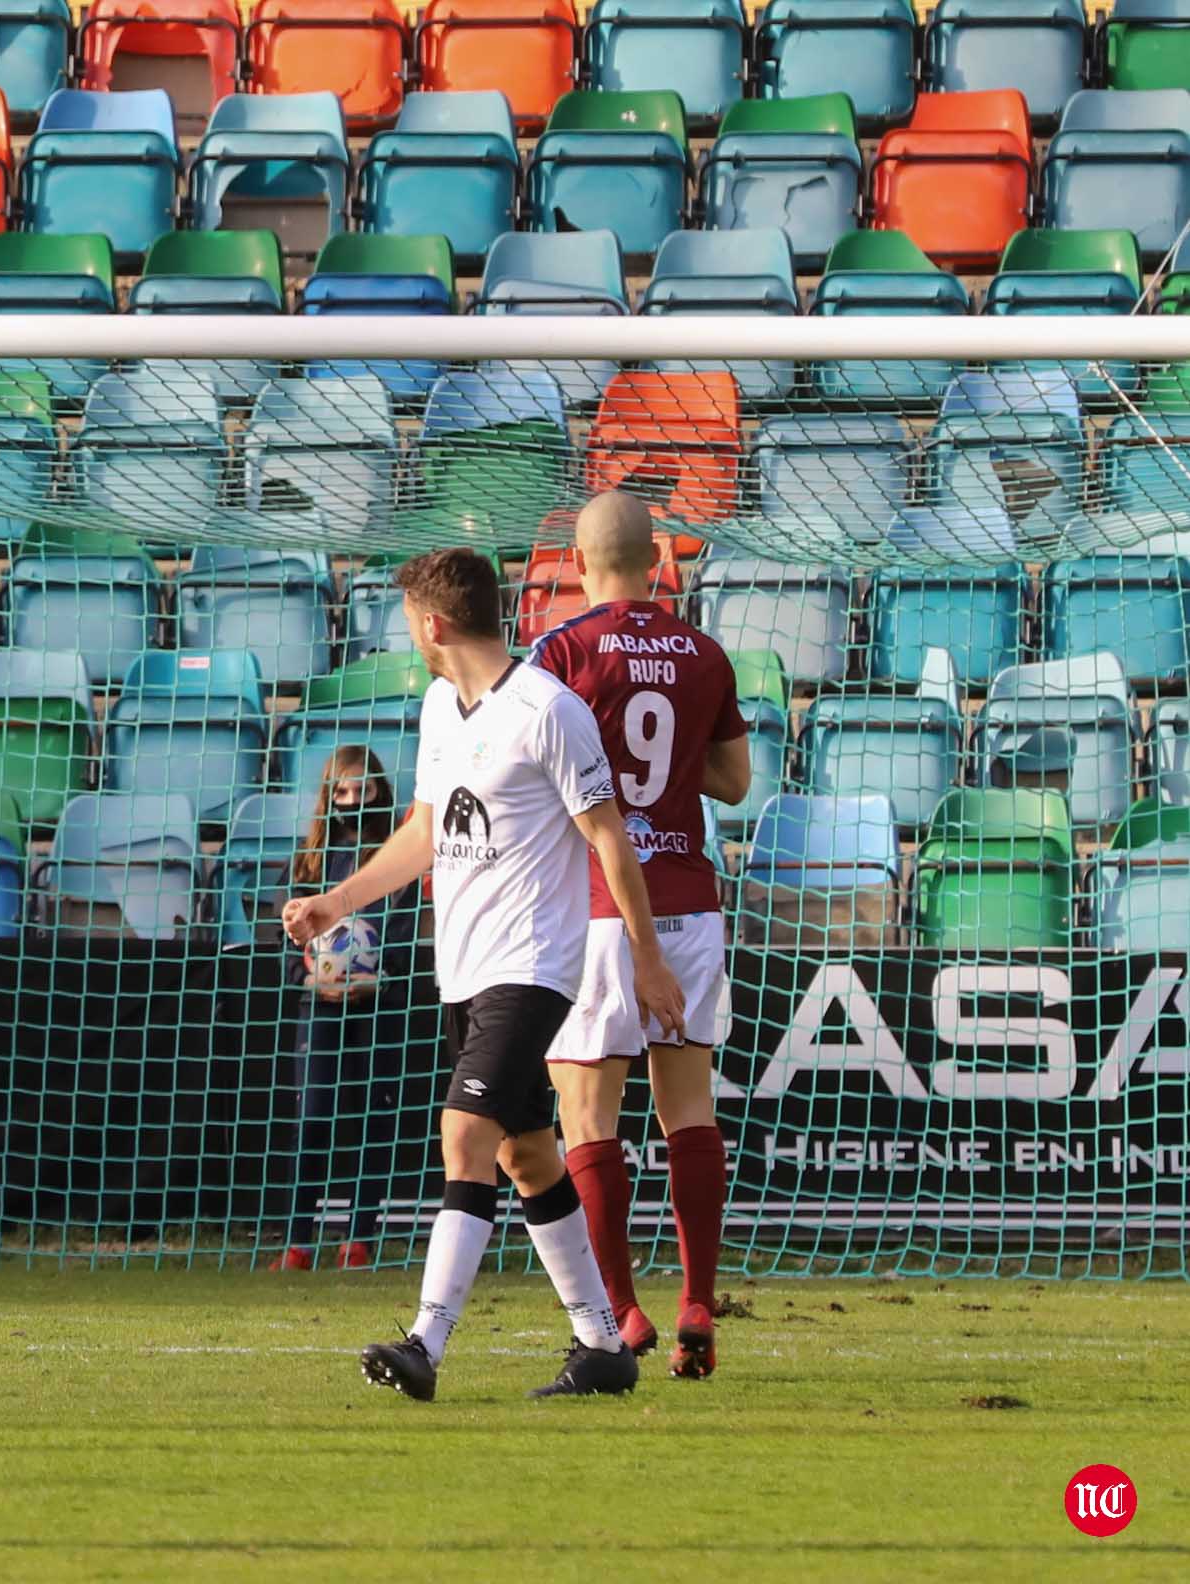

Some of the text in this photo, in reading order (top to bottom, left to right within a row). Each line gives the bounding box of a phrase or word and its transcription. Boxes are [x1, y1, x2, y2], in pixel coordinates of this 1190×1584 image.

[628, 659, 676, 685] RUFO
[619, 690, 676, 807] 9
[711, 964, 1190, 1100] ASA
[765, 1134, 990, 1172] HIGIENE
[1014, 1141, 1085, 1173] EN
